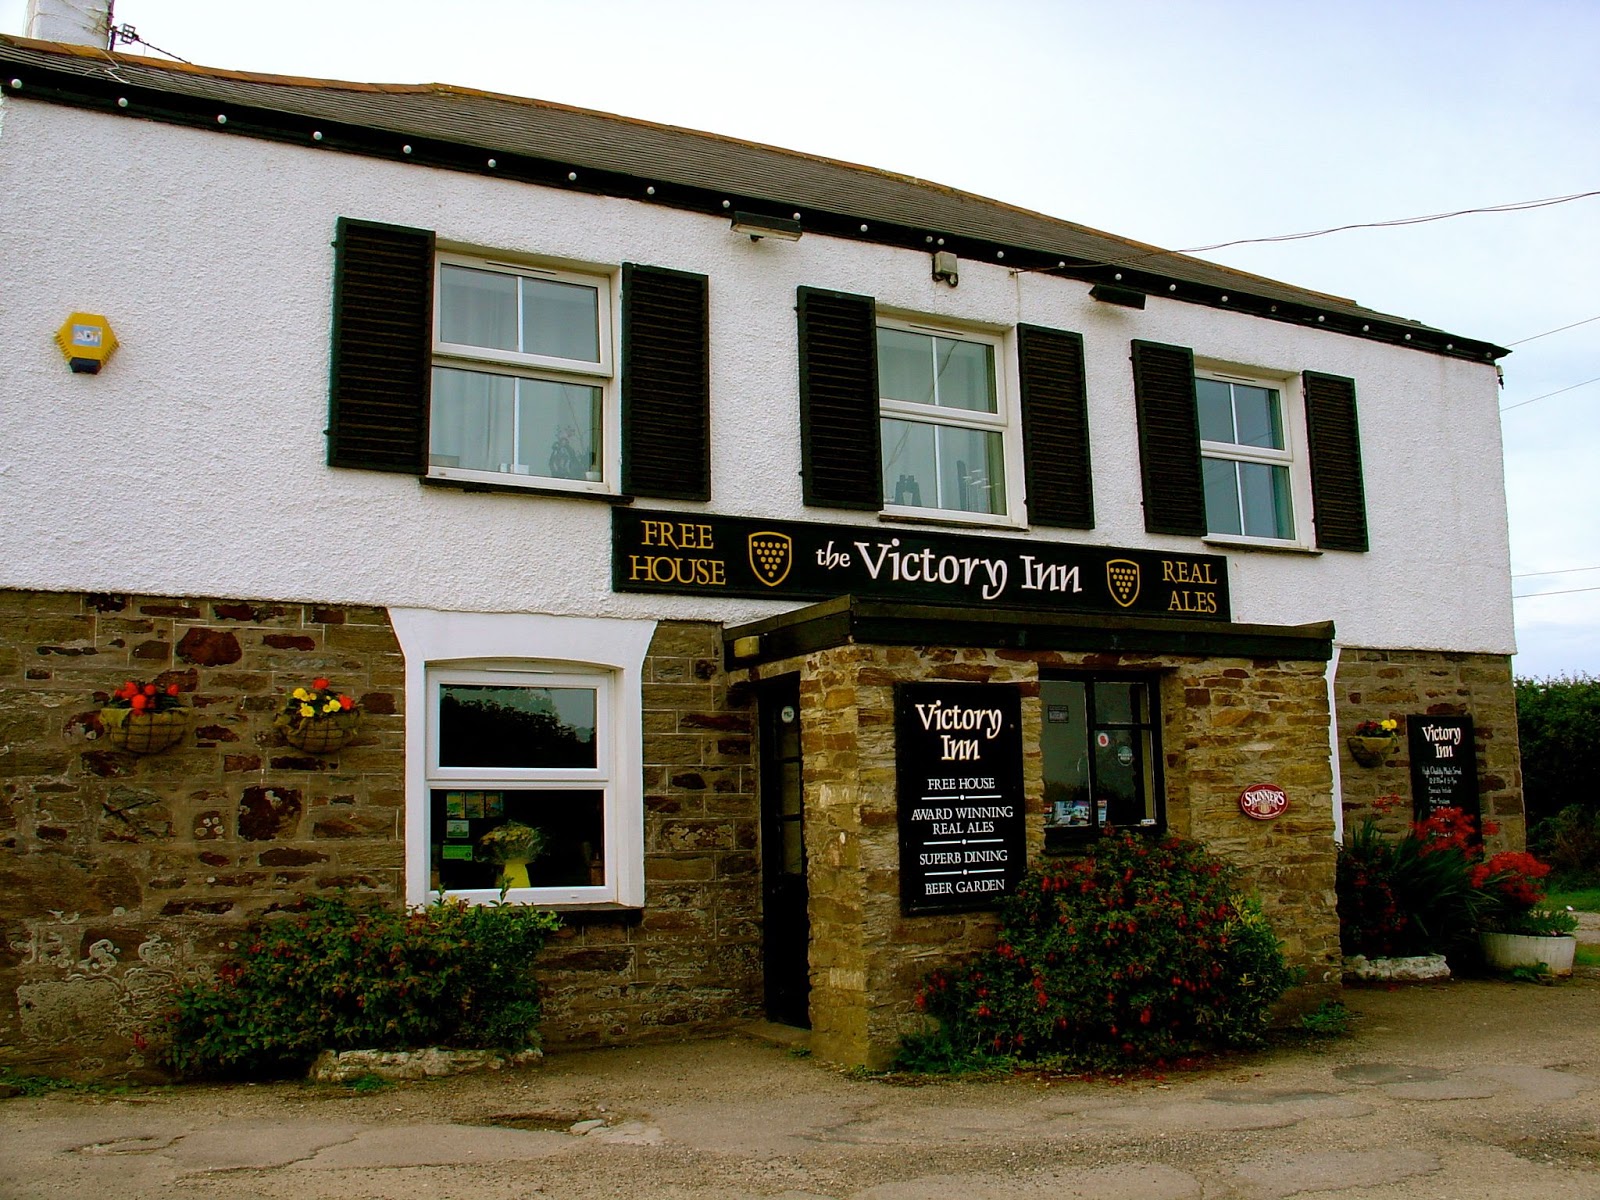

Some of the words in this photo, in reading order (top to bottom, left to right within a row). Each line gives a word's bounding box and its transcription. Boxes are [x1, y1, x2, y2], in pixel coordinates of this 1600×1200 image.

[641, 520, 714, 550] FREE
[629, 555, 726, 585] HOUSE
[816, 540, 851, 570] the
[854, 538, 1008, 600] Victory
[1019, 555, 1082, 593] Inn
[1162, 560, 1217, 585] REAL
[1167, 590, 1217, 614] ALES
[915, 700, 1002, 739] Victory
[1422, 724, 1461, 745] Victory
[940, 734, 981, 761] Inn
[1434, 743, 1453, 758] Inn
[927, 778, 956, 791] FREE
[958, 777, 996, 790] HOUSE
[911, 808, 953, 821] AWARD
[955, 805, 1014, 819] WINNING
[932, 823, 964, 836] REAL
[966, 821, 995, 834] ALES
[919, 852, 962, 866] SUPERB
[964, 849, 1008, 864] DINING
[924, 882, 954, 896] BEER
[955, 878, 1006, 894] GARDEN
